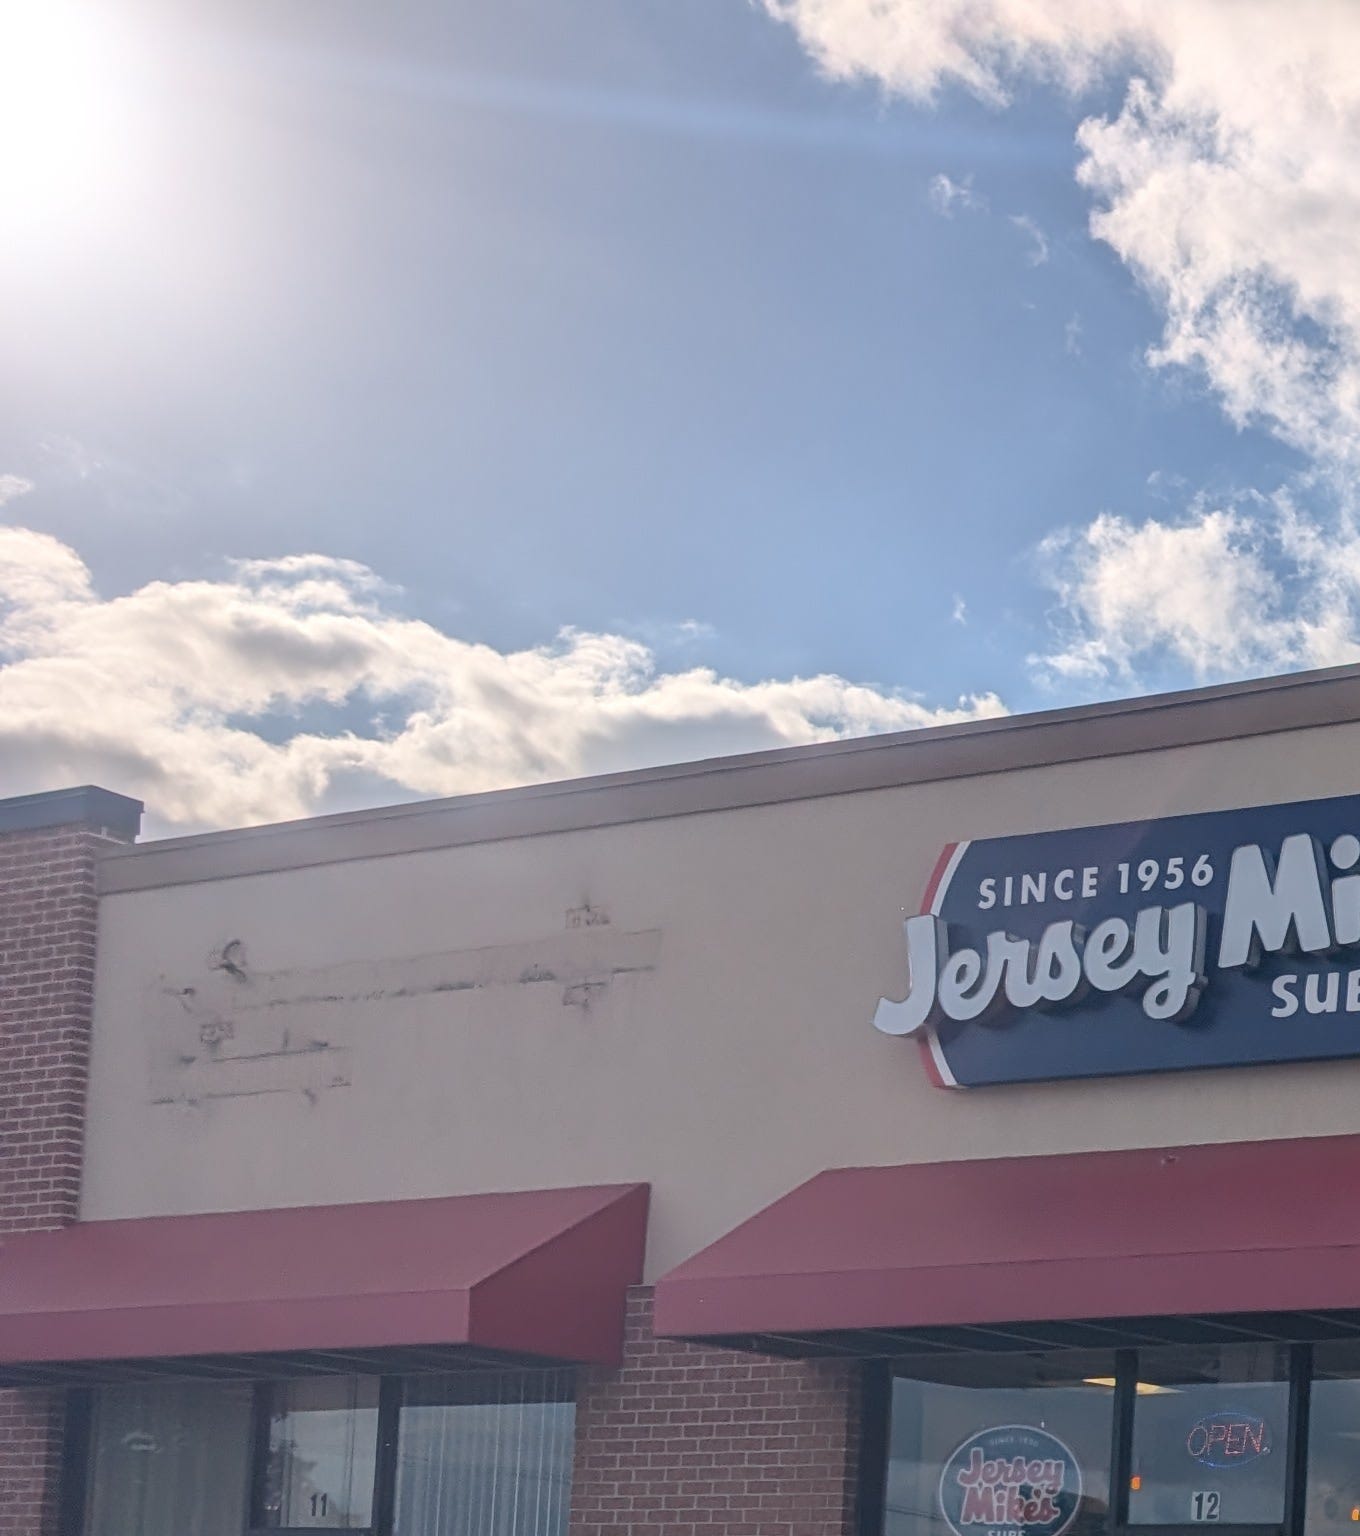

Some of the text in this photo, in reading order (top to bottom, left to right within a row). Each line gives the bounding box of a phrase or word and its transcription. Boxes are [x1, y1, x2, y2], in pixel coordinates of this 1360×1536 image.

[977, 854, 1215, 910] SINCE 1956
[872, 901, 1199, 1036] Jersey
[1187, 1422, 1264, 1456] OPEN
[957, 1447, 1065, 1496] Jersey
[310, 1493, 327, 1517] 11
[960, 1485, 1062, 1526] Mike's
[1195, 1492, 1219, 1520] 12
